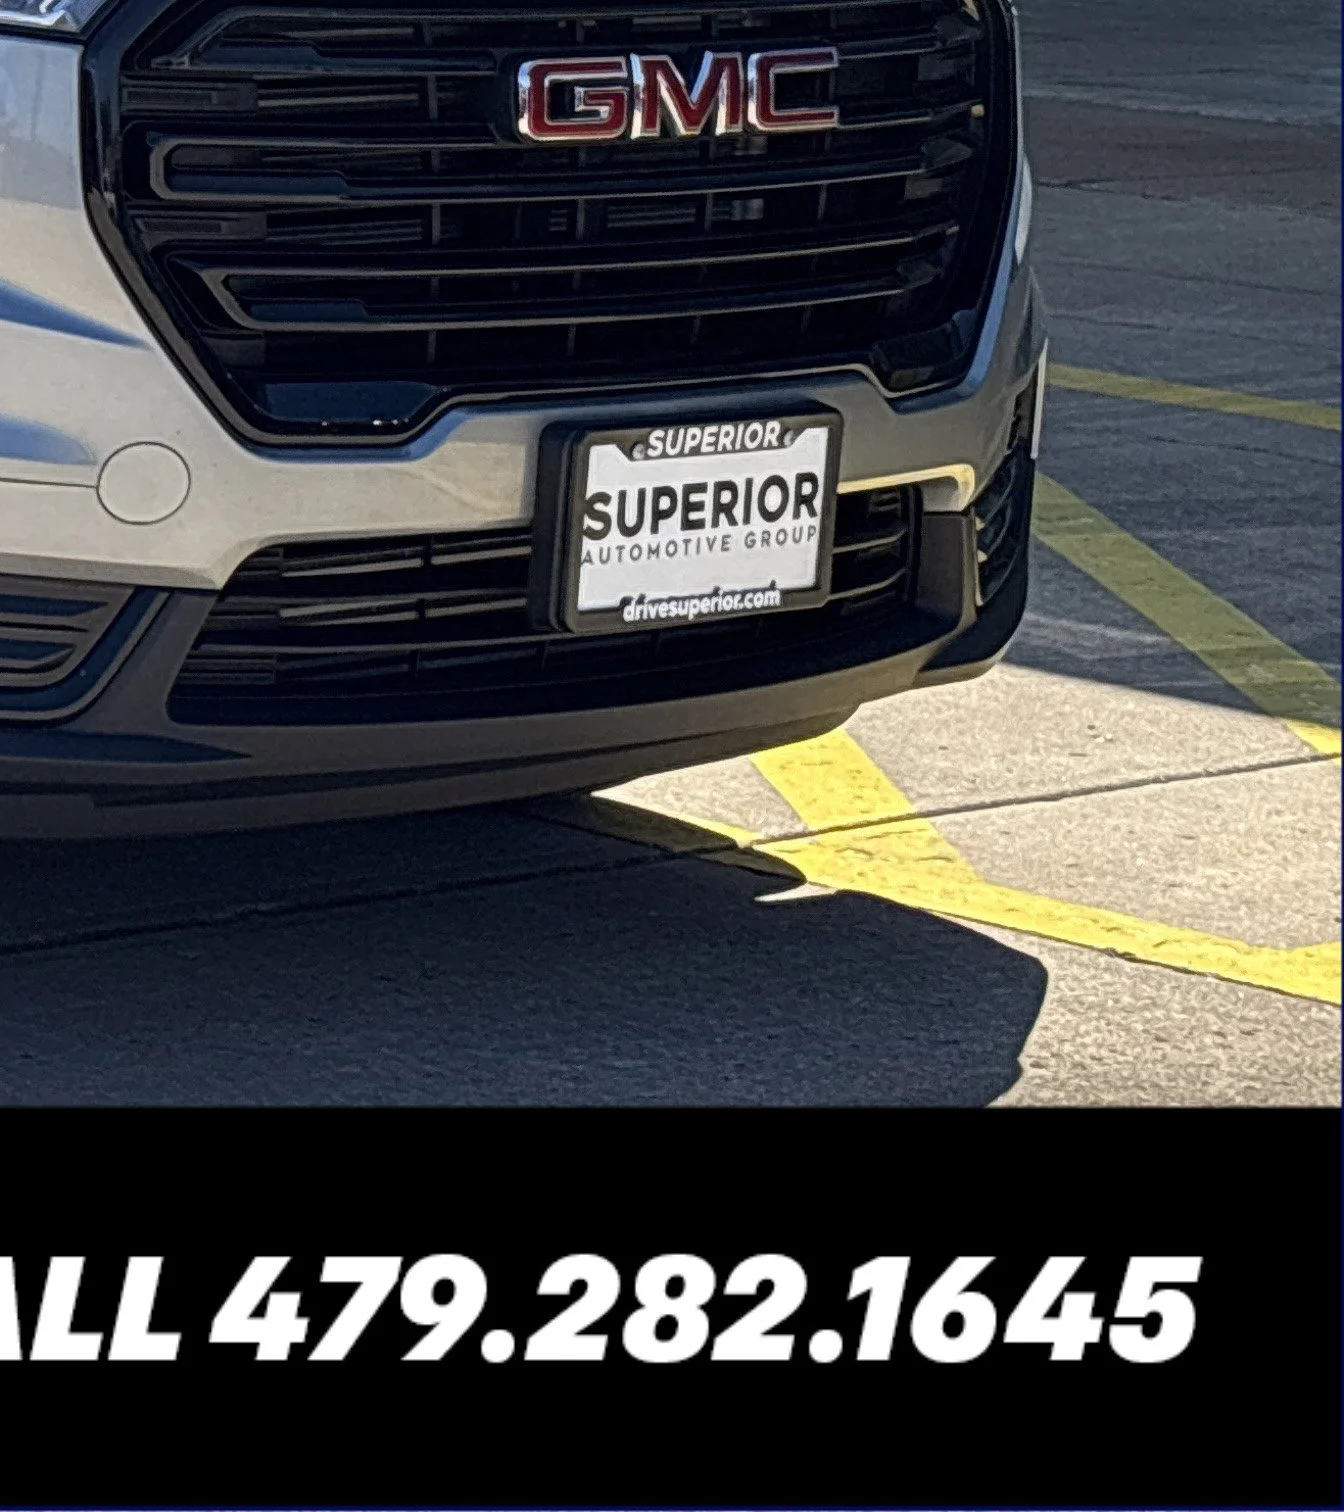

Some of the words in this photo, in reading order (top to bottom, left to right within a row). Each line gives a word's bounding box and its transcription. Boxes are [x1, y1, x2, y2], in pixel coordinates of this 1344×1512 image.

[517, 46, 840, 142] GMC
[646, 420, 782, 458] SUPERIOR
[582, 471, 820, 541] SUPERIOR
[580, 534, 733, 567] AUTOMOTIVE
[745, 524, 818, 551] GROUP
[622, 587, 782, 622] drivesuperior.com
